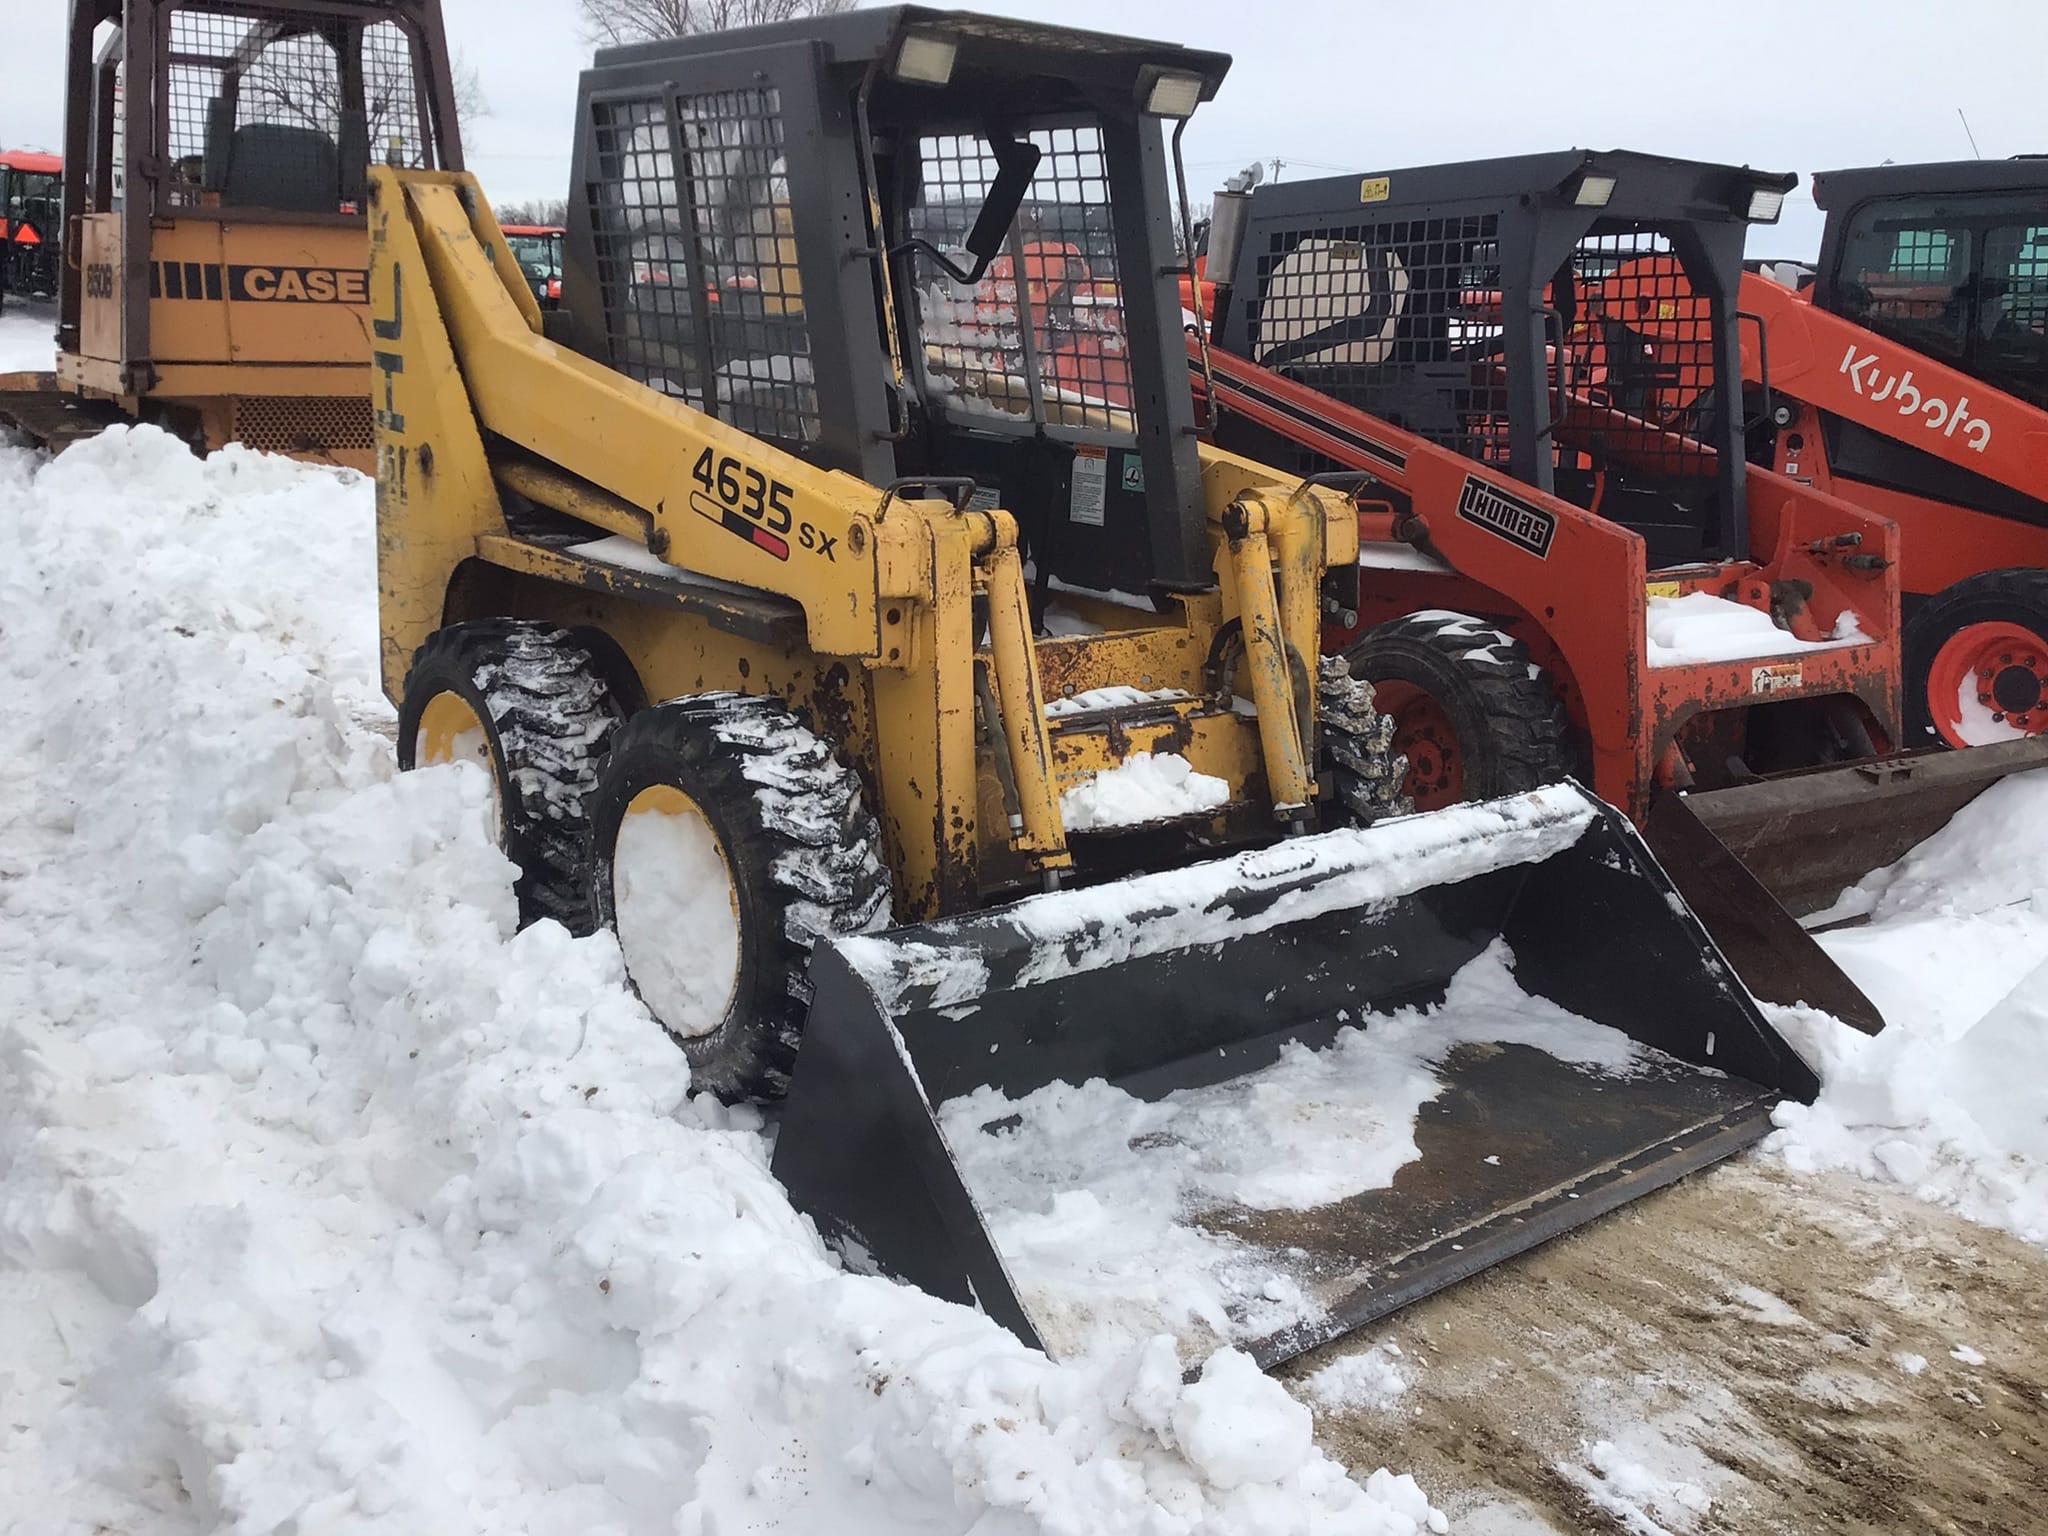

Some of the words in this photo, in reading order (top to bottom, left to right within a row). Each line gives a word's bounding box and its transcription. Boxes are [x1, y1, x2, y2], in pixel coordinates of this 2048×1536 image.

[243, 267, 367, 302] CASE
[1839, 344, 1991, 453] Kubota
[692, 446, 794, 535] 4635
[798, 521, 839, 564] SX
